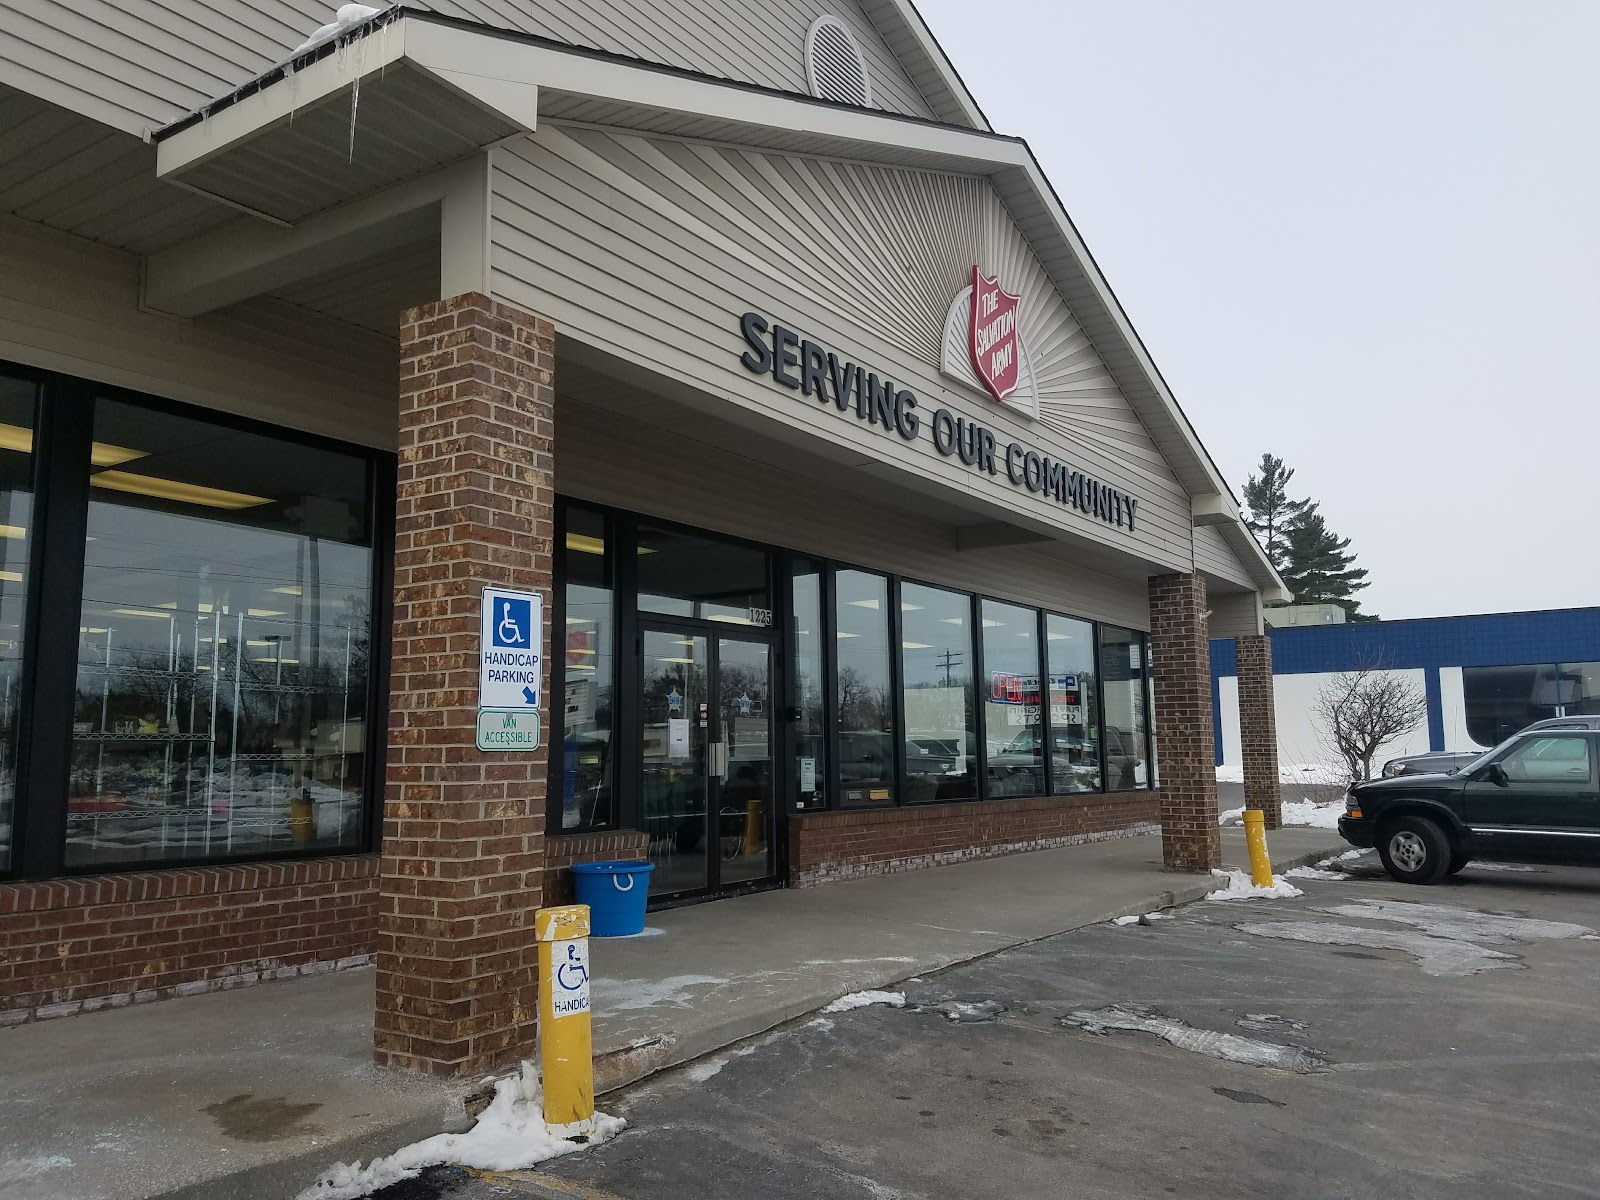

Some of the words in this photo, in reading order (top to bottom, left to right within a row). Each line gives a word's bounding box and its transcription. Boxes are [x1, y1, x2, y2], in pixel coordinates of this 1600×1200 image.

[982, 289, 998, 318] THE
[978, 305, 1015, 357] SALVATION
[991, 340, 1013, 380] ARMY
[741, 312, 920, 440] SERVING
[932, 408, 997, 475] OUR
[1006, 443, 1138, 532] COMMUNITY
[750, 608, 772, 626] 1225
[484, 652, 539, 667] HANDICAP
[488, 670, 534, 684] PARKING
[992, 673, 1023, 701] OPEN
[502, 718, 517, 729] VAN
[485, 731, 532, 743] ACCESSIBLE
